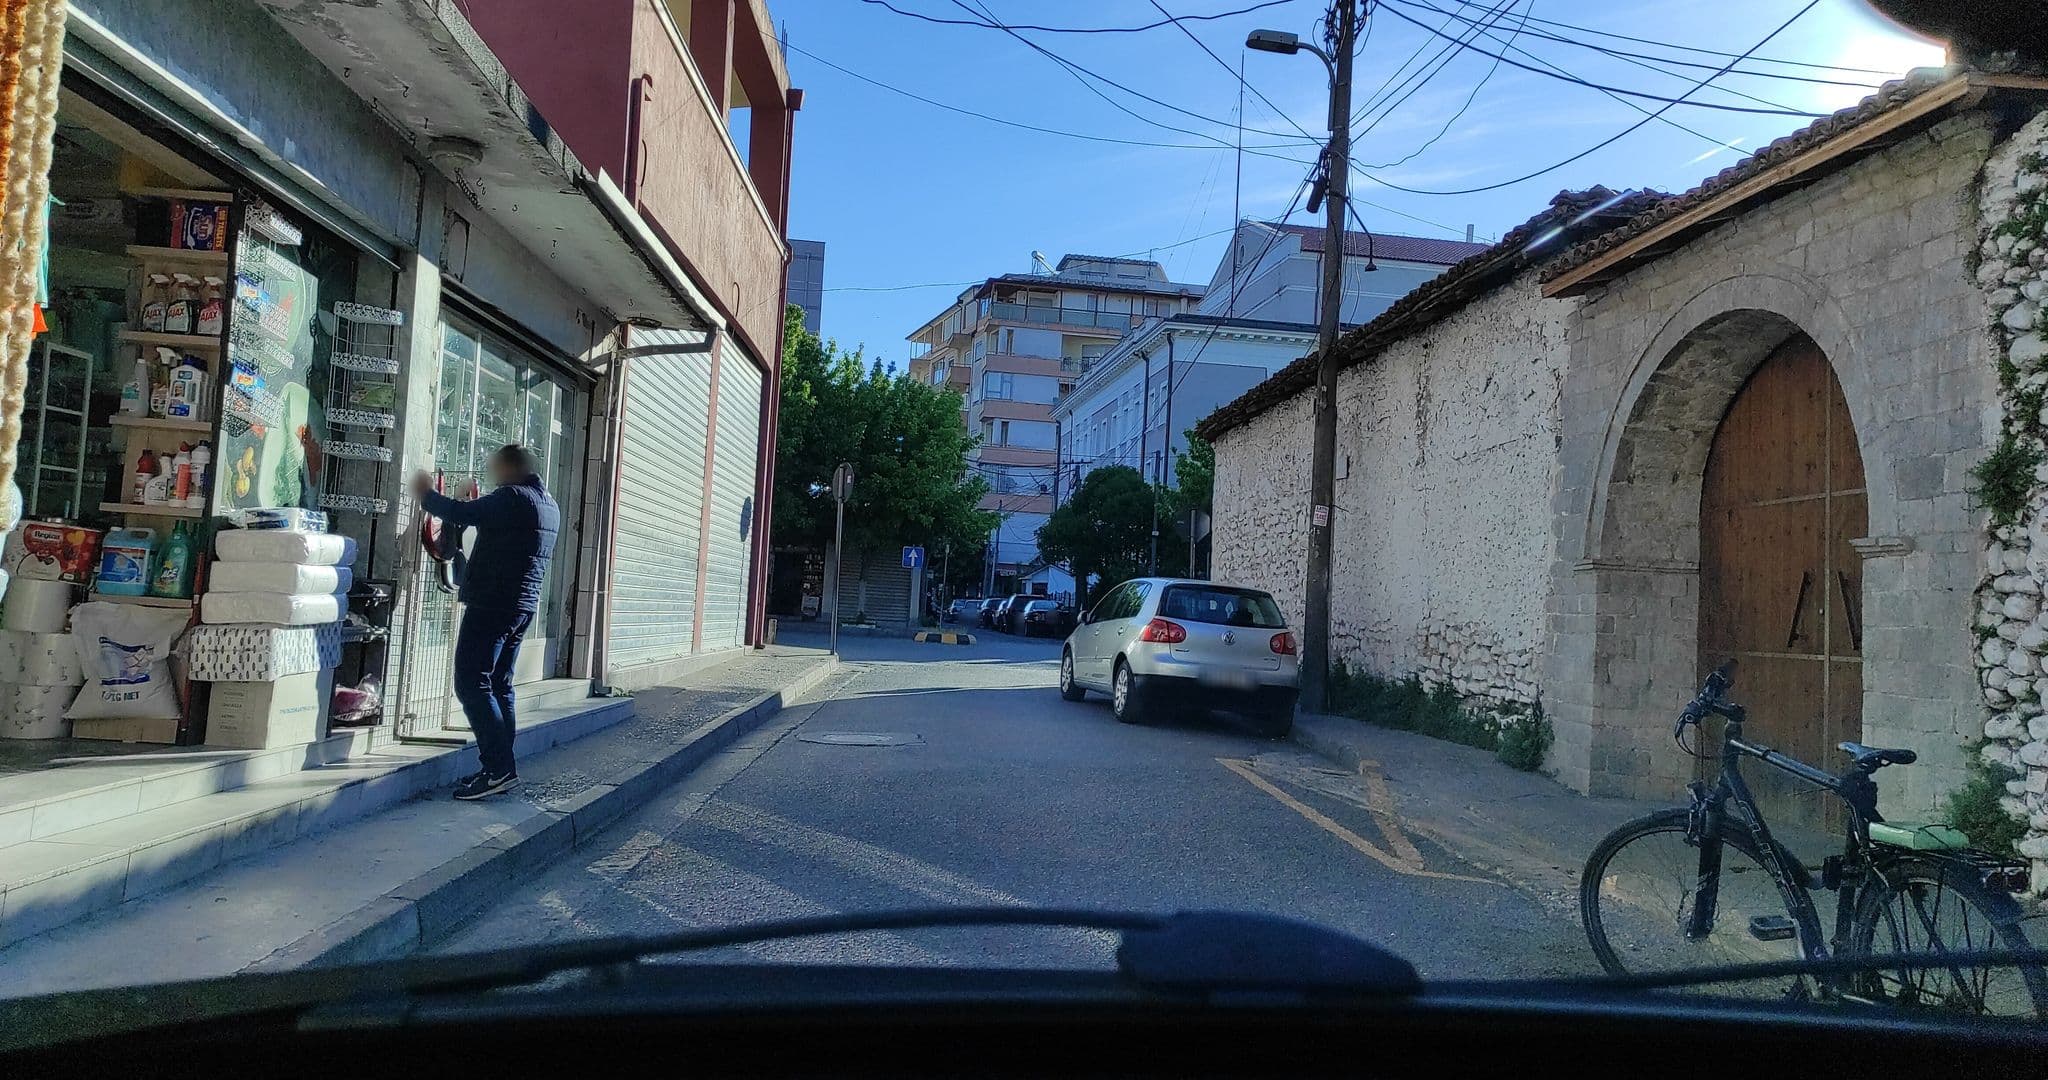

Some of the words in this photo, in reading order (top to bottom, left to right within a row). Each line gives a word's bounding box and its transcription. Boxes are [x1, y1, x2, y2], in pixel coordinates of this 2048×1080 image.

[144, 308, 161, 319] AJAX
[168, 307, 184, 318] AJAX
[201, 310, 218, 322] AJAX
